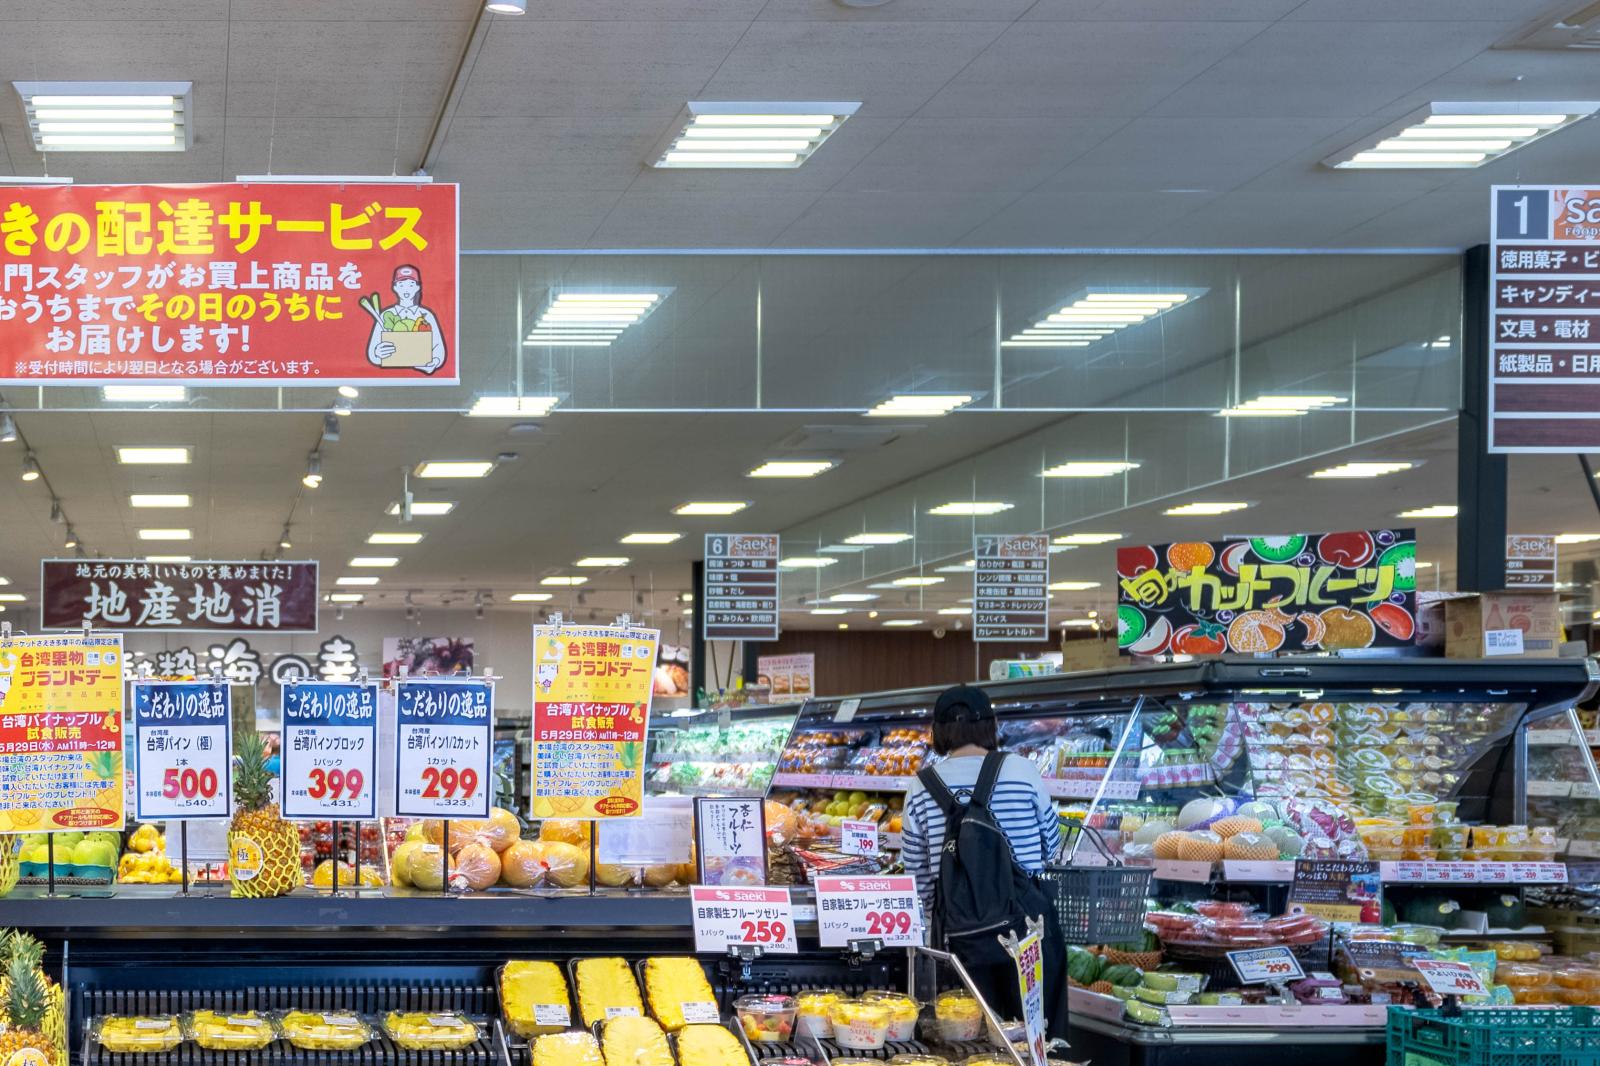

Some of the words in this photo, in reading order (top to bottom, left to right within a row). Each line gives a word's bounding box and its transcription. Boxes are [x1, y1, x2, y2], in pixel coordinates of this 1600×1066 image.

[1514, 195, 1528, 235] 1
[1500, 319, 1590, 338] 文具・電材
[712, 538, 723, 554] 6
[982, 538, 993, 555] 7
[1512, 540, 1551, 551] saeki
[83, 581, 284, 628] 地産地消
[979, 615, 1007, 623] スパイス
[978, 628, 1036, 636] カレー・レトルト
[568, 642, 621, 657] 台湾果物
[20, 651, 84, 667] 台湾果物
[568, 661, 647, 677] ブランドデー
[20, 670, 117, 687] ブランドデー
[139, 691, 225, 719] こだわりの逸品
[286, 690, 373, 720] こだわりの逸品
[401, 690, 487, 718] こだわりの逸品
[546, 703, 630, 717] 台湾パイナップル
[2, 714, 102, 728] 台湾パイナップル
[571, 717, 615, 729] 試食販売
[27, 727, 82, 740] 試食販売
[293, 736, 365, 751] 台湾パインブロック
[175, 758, 188, 766] 1本
[313, 758, 343, 766] 1パック
[163, 768, 218, 799] 500
[308, 768, 364, 799] 399
[421, 767, 478, 799] 299
[739, 804, 755, 831] 杏仁
[728, 807, 742, 855] フルーツ
[859, 880, 891, 891] saeki
[734, 891, 766, 900] saeki
[822, 897, 914, 911] 自家製生フルーツ杏仁豆腐
[698, 907, 788, 919] 自家製生フルーツゼリー
[866, 911, 912, 935] 299
[741, 920, 786, 943] 259
[1265, 963, 1291, 974] 299
[1455, 978, 1480, 991] 499
